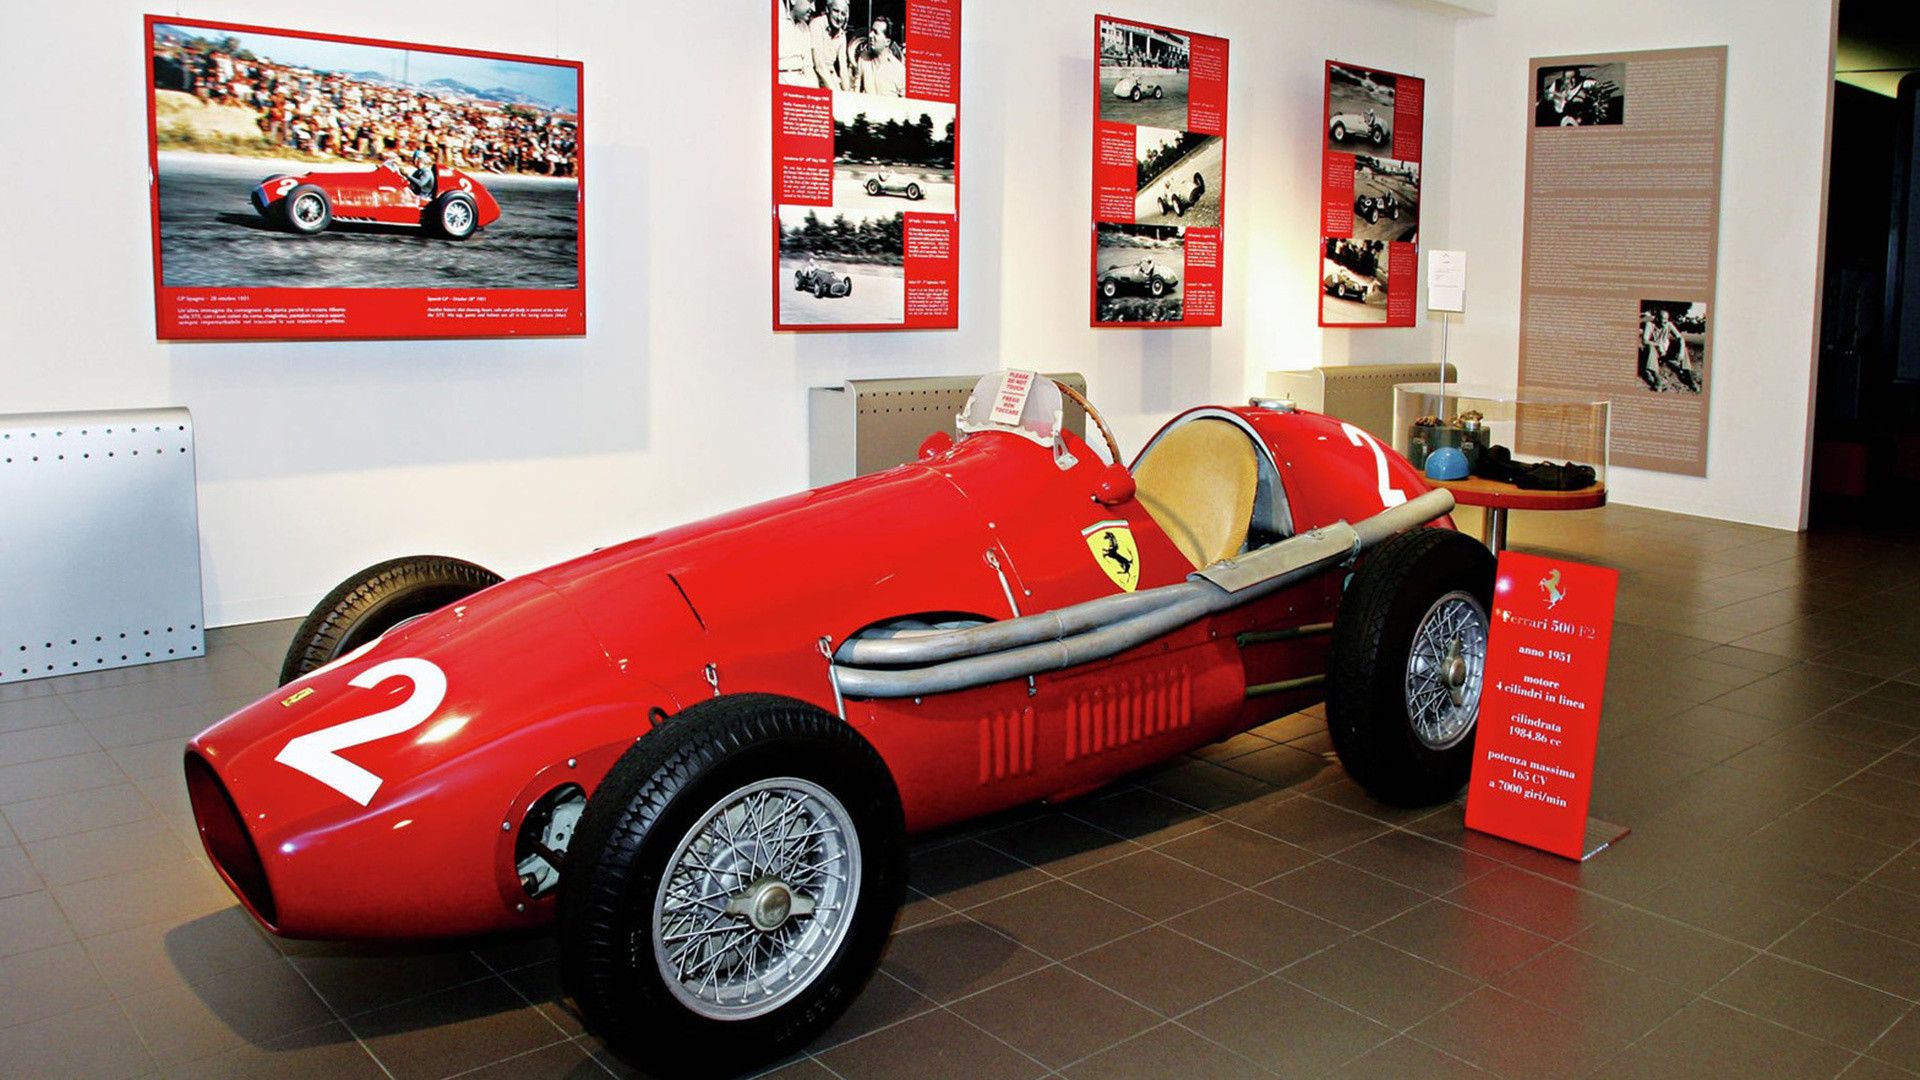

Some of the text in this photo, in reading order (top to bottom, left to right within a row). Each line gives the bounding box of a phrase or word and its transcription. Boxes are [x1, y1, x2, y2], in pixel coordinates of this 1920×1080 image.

[1341, 422, 1408, 508] 2
[1502, 610, 1548, 630] Ferrari
[1551, 620, 1575, 635] 500
[1519, 646, 1571, 664] anno 1951
[1523, 675, 1560, 690] motore
[1496, 681, 1585, 710] 4 cilindri in linea
[274, 657, 448, 808] 2
[1511, 713, 1562, 733] cilindrata
[1509, 725, 1562, 747] 1984.86 cc
[1488, 751, 1576, 780] potenza massima
[1512, 768, 1548, 786] 165 CV
[1489, 780, 1567, 807] a 7000 giri/min
